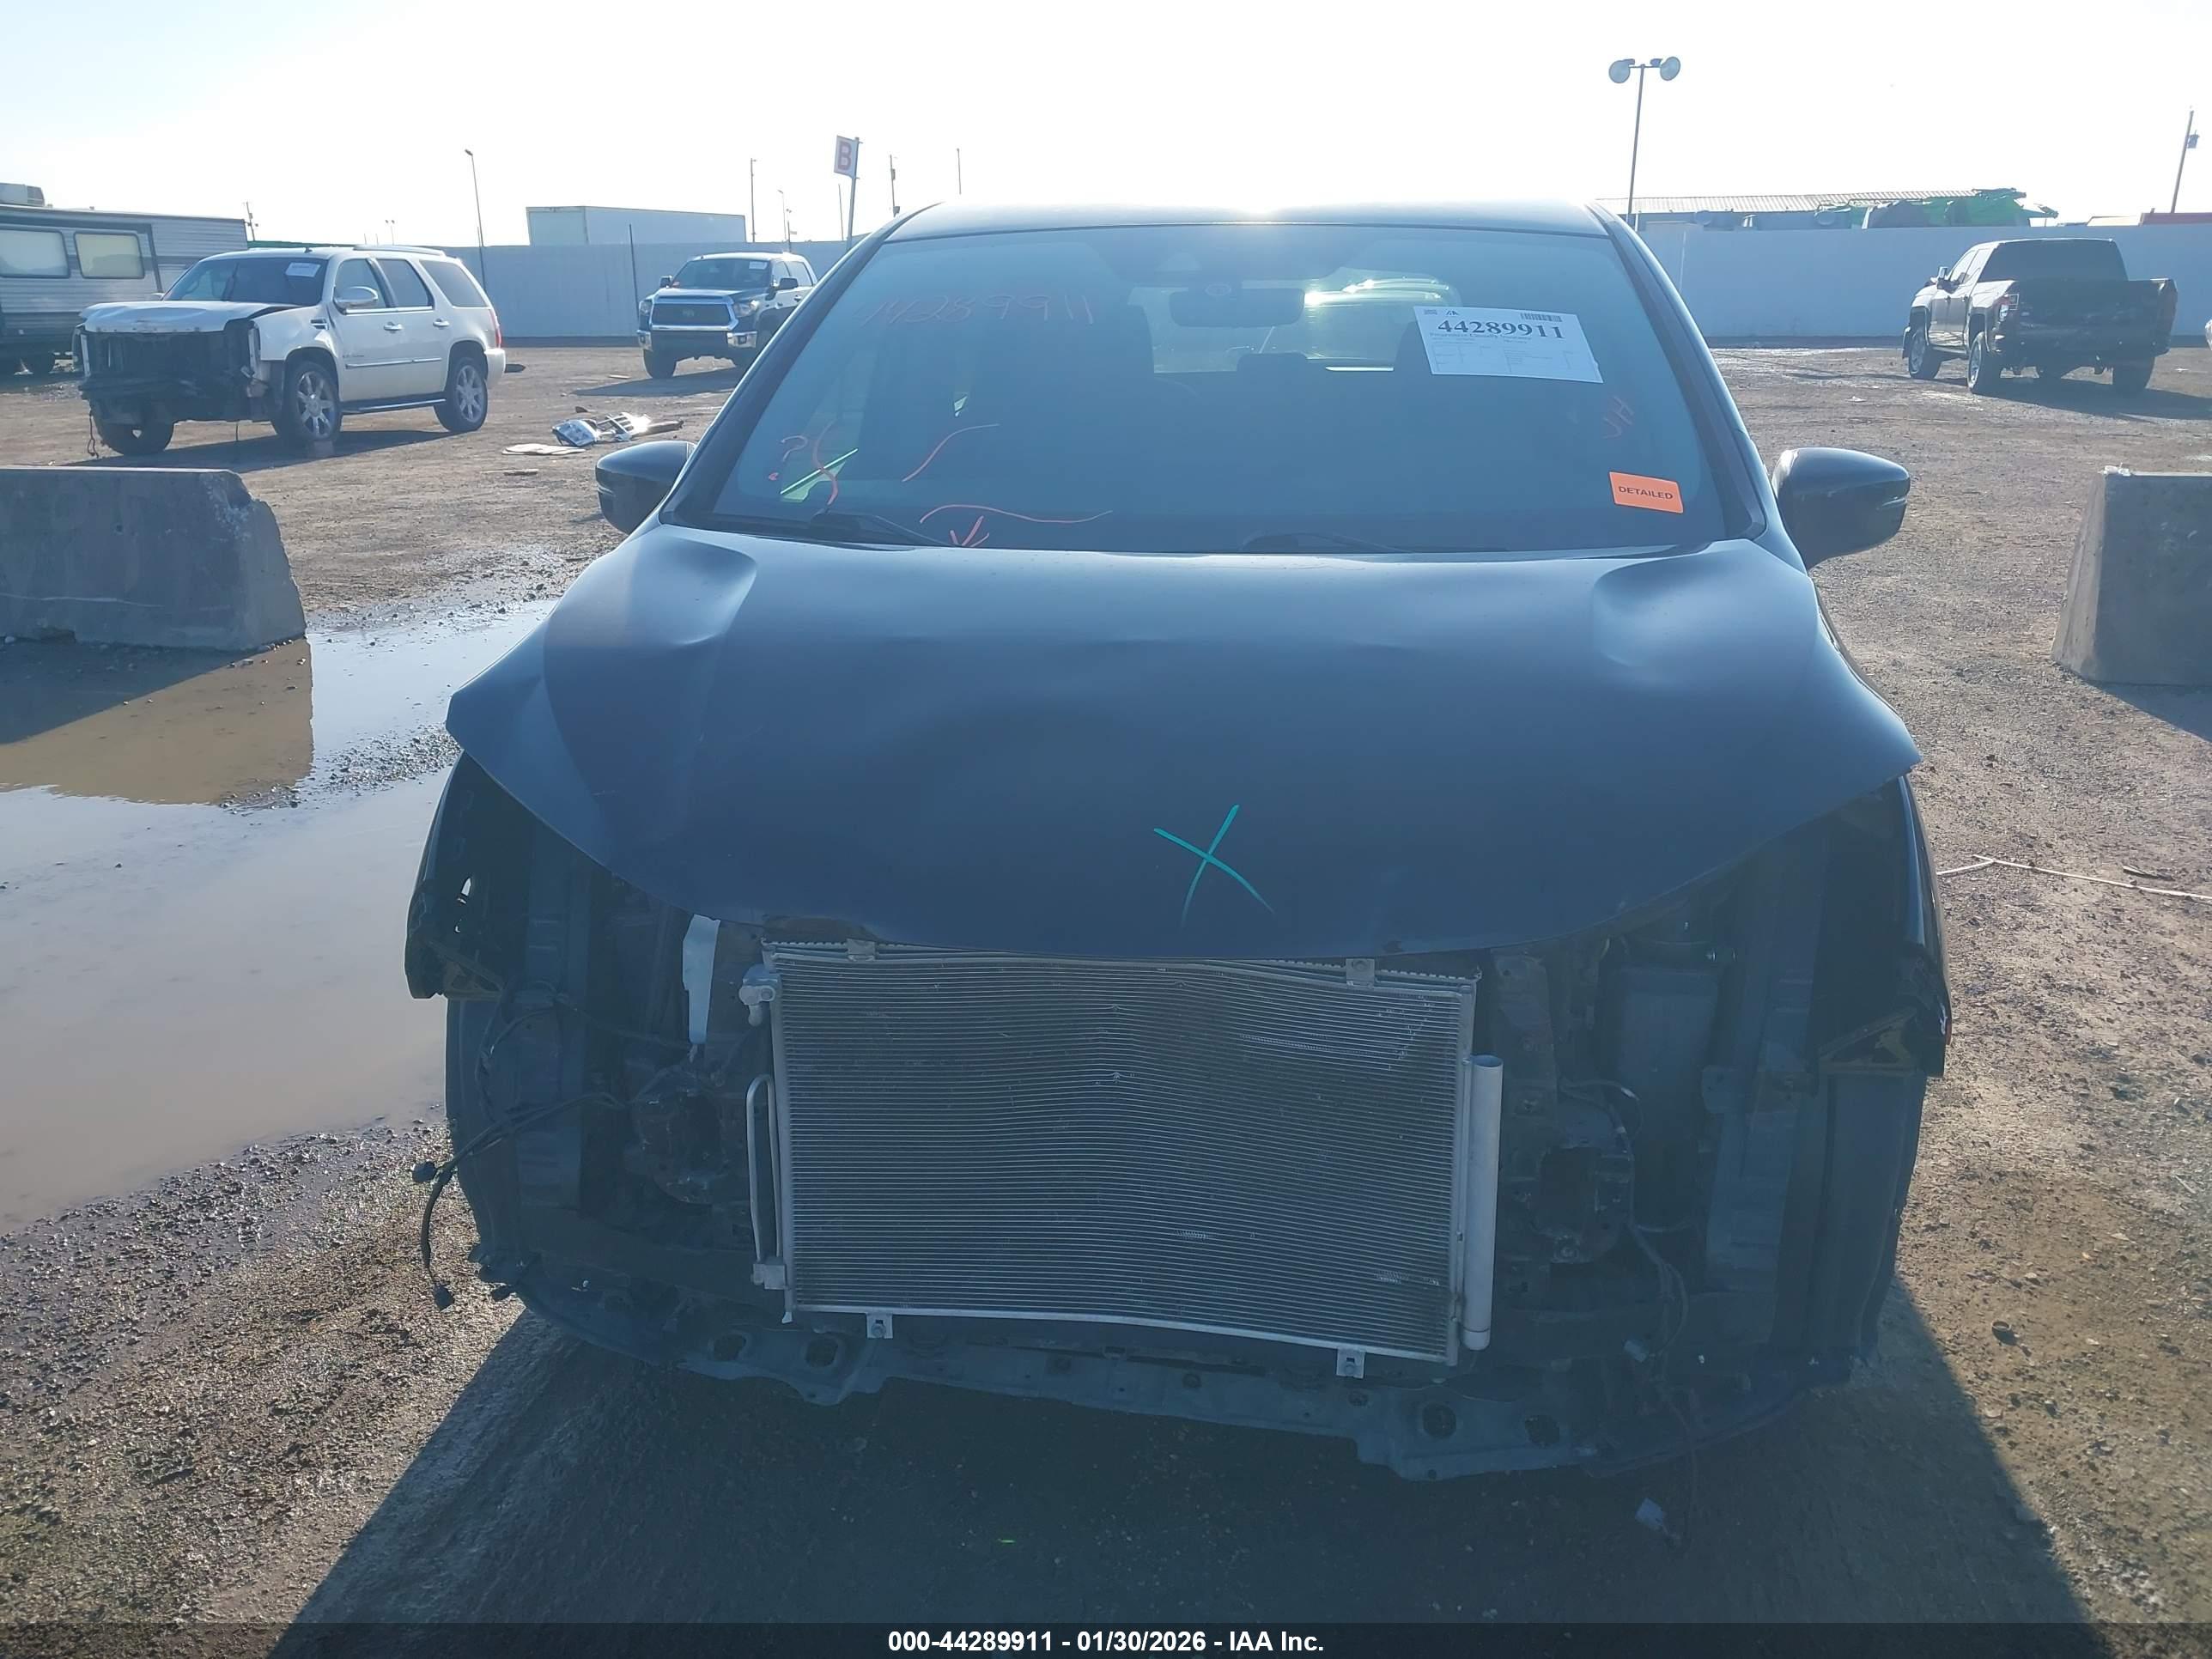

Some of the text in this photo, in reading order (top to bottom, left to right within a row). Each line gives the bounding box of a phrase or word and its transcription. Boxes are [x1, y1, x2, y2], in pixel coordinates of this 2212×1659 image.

[838, 141, 852, 170] B
[1437, 319, 1565, 339] 44289911
[1618, 485, 1674, 501] DETAILED
